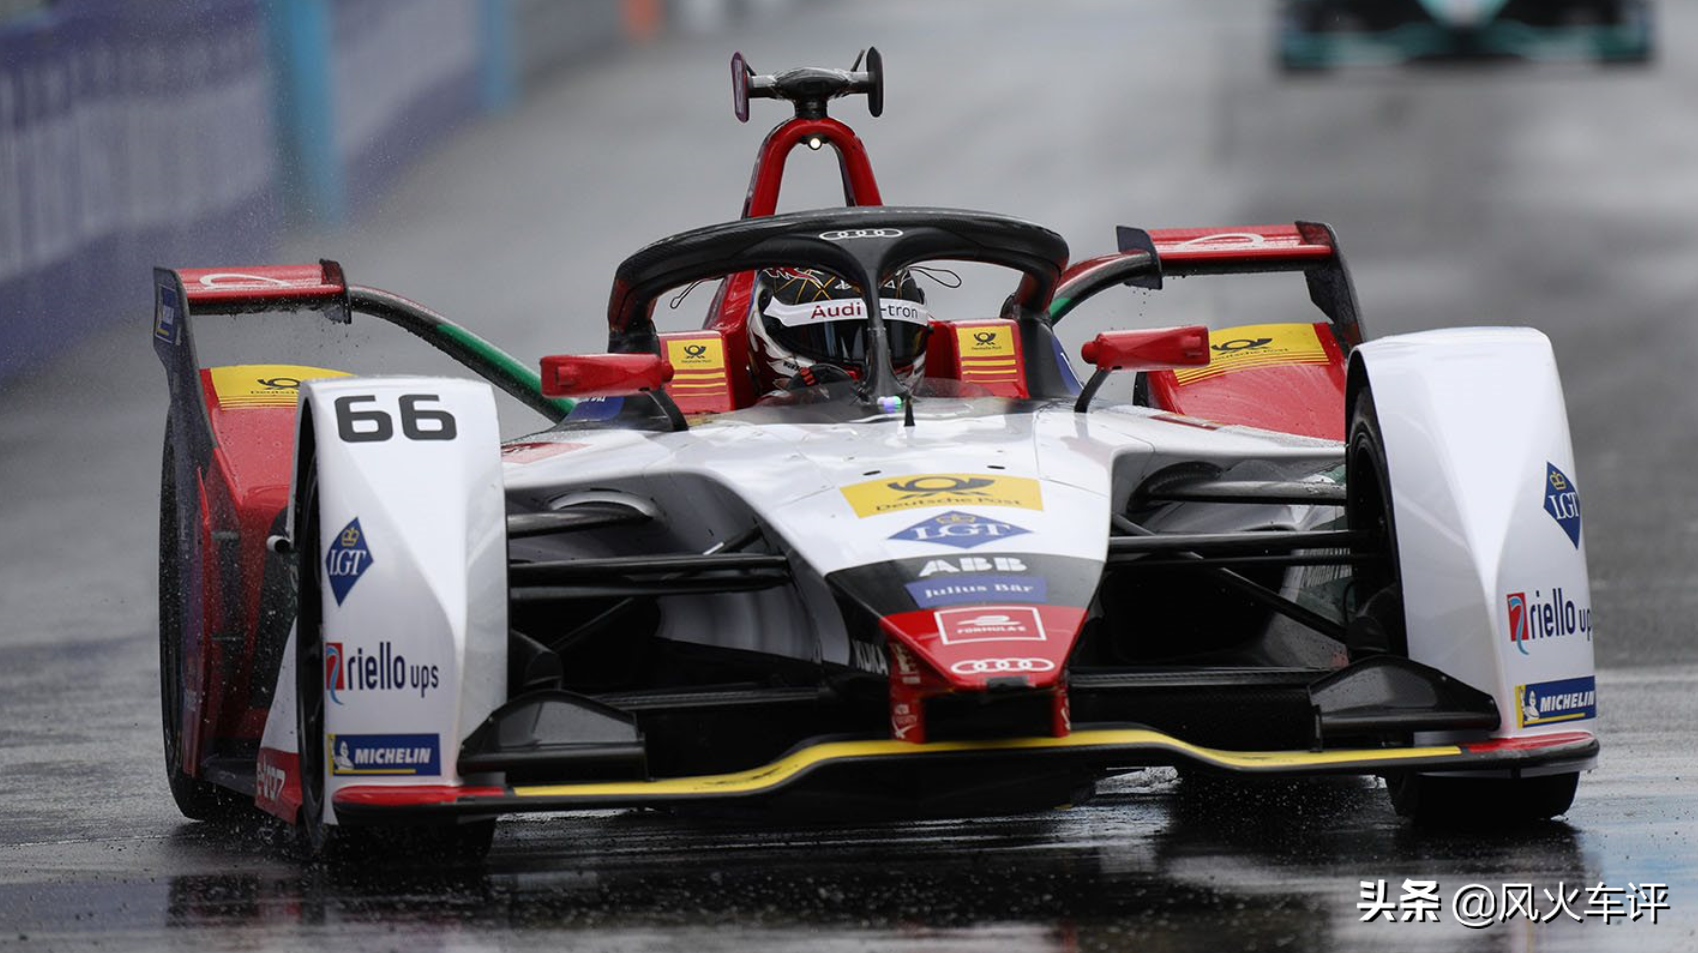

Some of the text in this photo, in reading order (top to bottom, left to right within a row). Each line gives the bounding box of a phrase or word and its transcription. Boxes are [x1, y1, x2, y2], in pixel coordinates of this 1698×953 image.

[810, 302, 918, 319] Audi -tron
[334, 394, 457, 443] 66
[875, 497, 973, 511] Deutsche
[1548, 491, 1579, 520] LGT
[910, 522, 1011, 540] LGT
[329, 549, 367, 576] LGT
[918, 557, 1028, 577] ABB
[924, 583, 988, 599] Julius
[1530, 587, 1592, 642] riello up
[347, 641, 439, 698] riello ups
[1539, 690, 1595, 713] MICHELIN
[354, 747, 431, 765] MICHELIN
